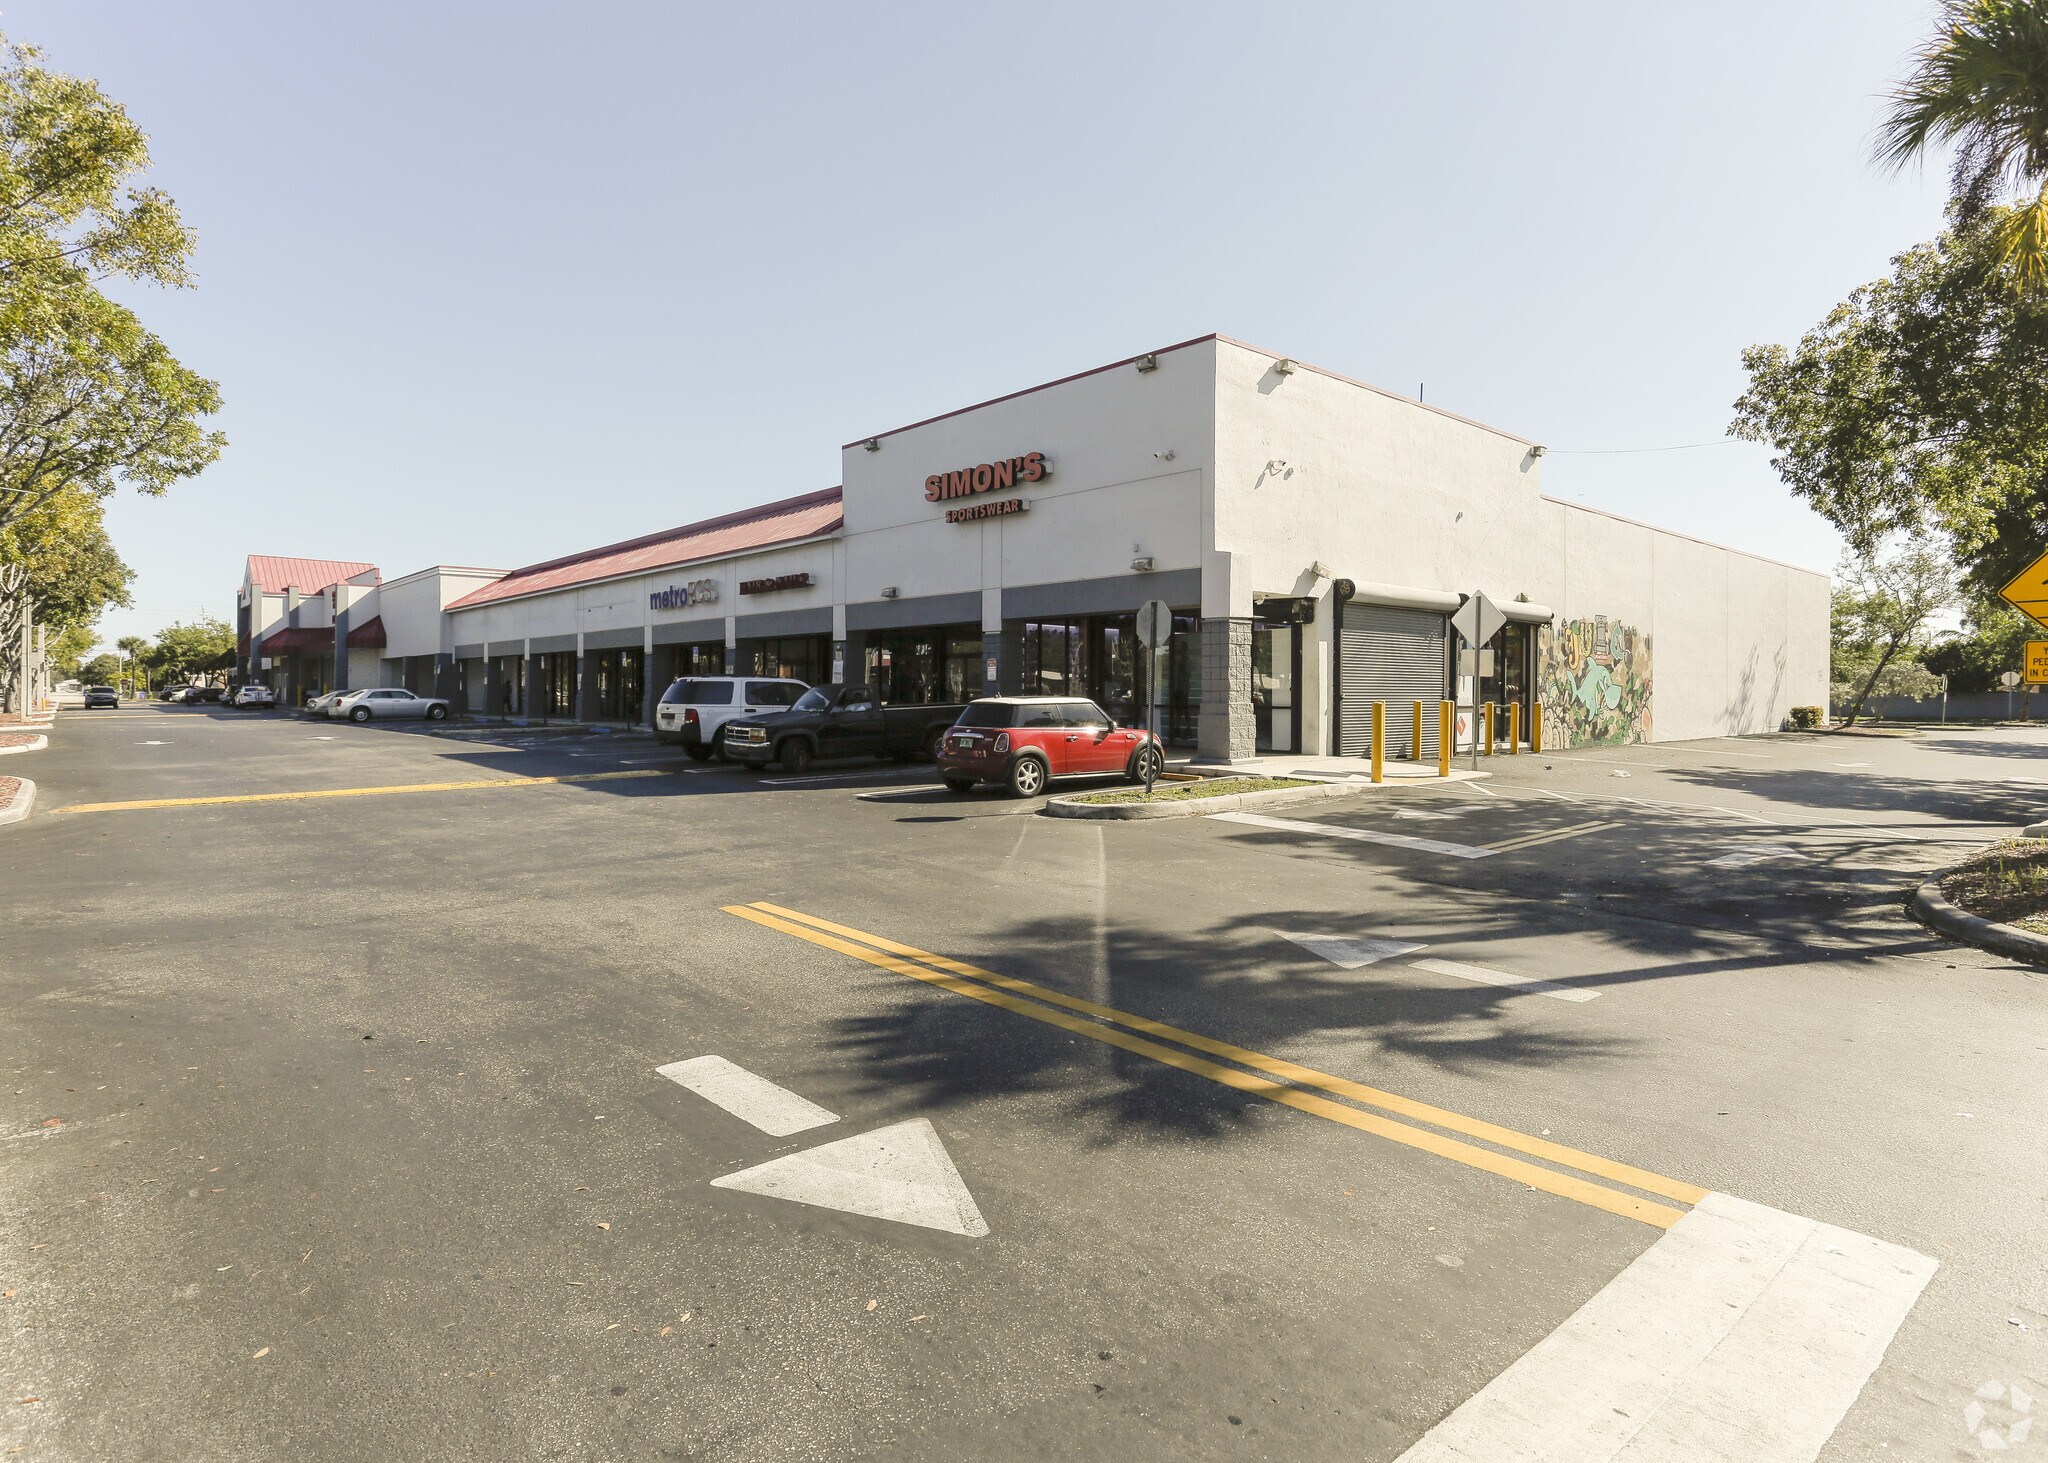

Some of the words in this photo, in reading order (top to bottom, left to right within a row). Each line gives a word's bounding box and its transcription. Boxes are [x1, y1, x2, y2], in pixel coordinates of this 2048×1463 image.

[925, 452, 1044, 502] SIMON'S
[945, 499, 1020, 523] SPORTSWEAR
[650, 578, 714, 610] metroPCS
[2029, 668, 2039, 677] IN
